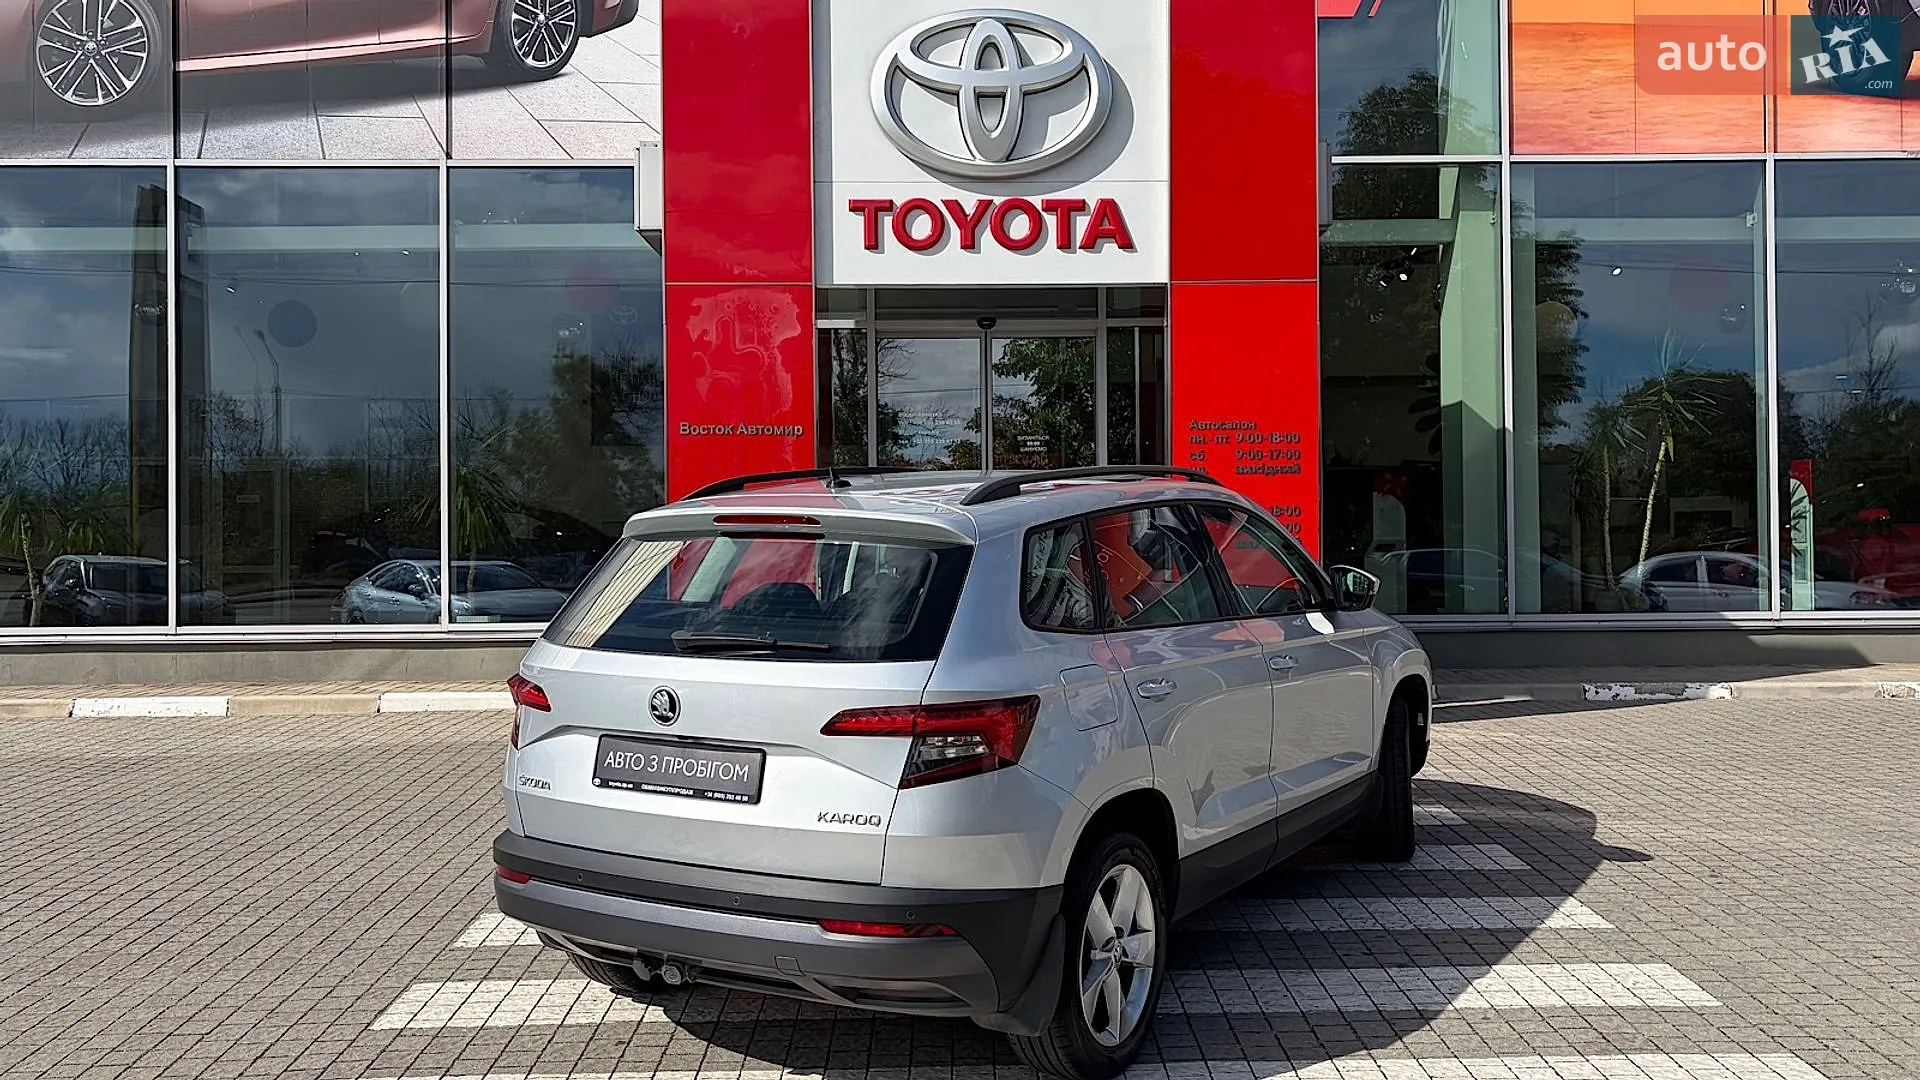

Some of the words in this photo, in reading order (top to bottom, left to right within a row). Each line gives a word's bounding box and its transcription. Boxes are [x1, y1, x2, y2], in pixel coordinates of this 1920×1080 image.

[848, 197, 1134, 252] TOYOTA
[679, 421, 733, 436] Восток
[736, 422, 803, 439] Автомир
[604, 750, 645, 771] АВТО
[661, 756, 749, 783] ПРОБІГОМ
[817, 810, 882, 828] KAROQ
